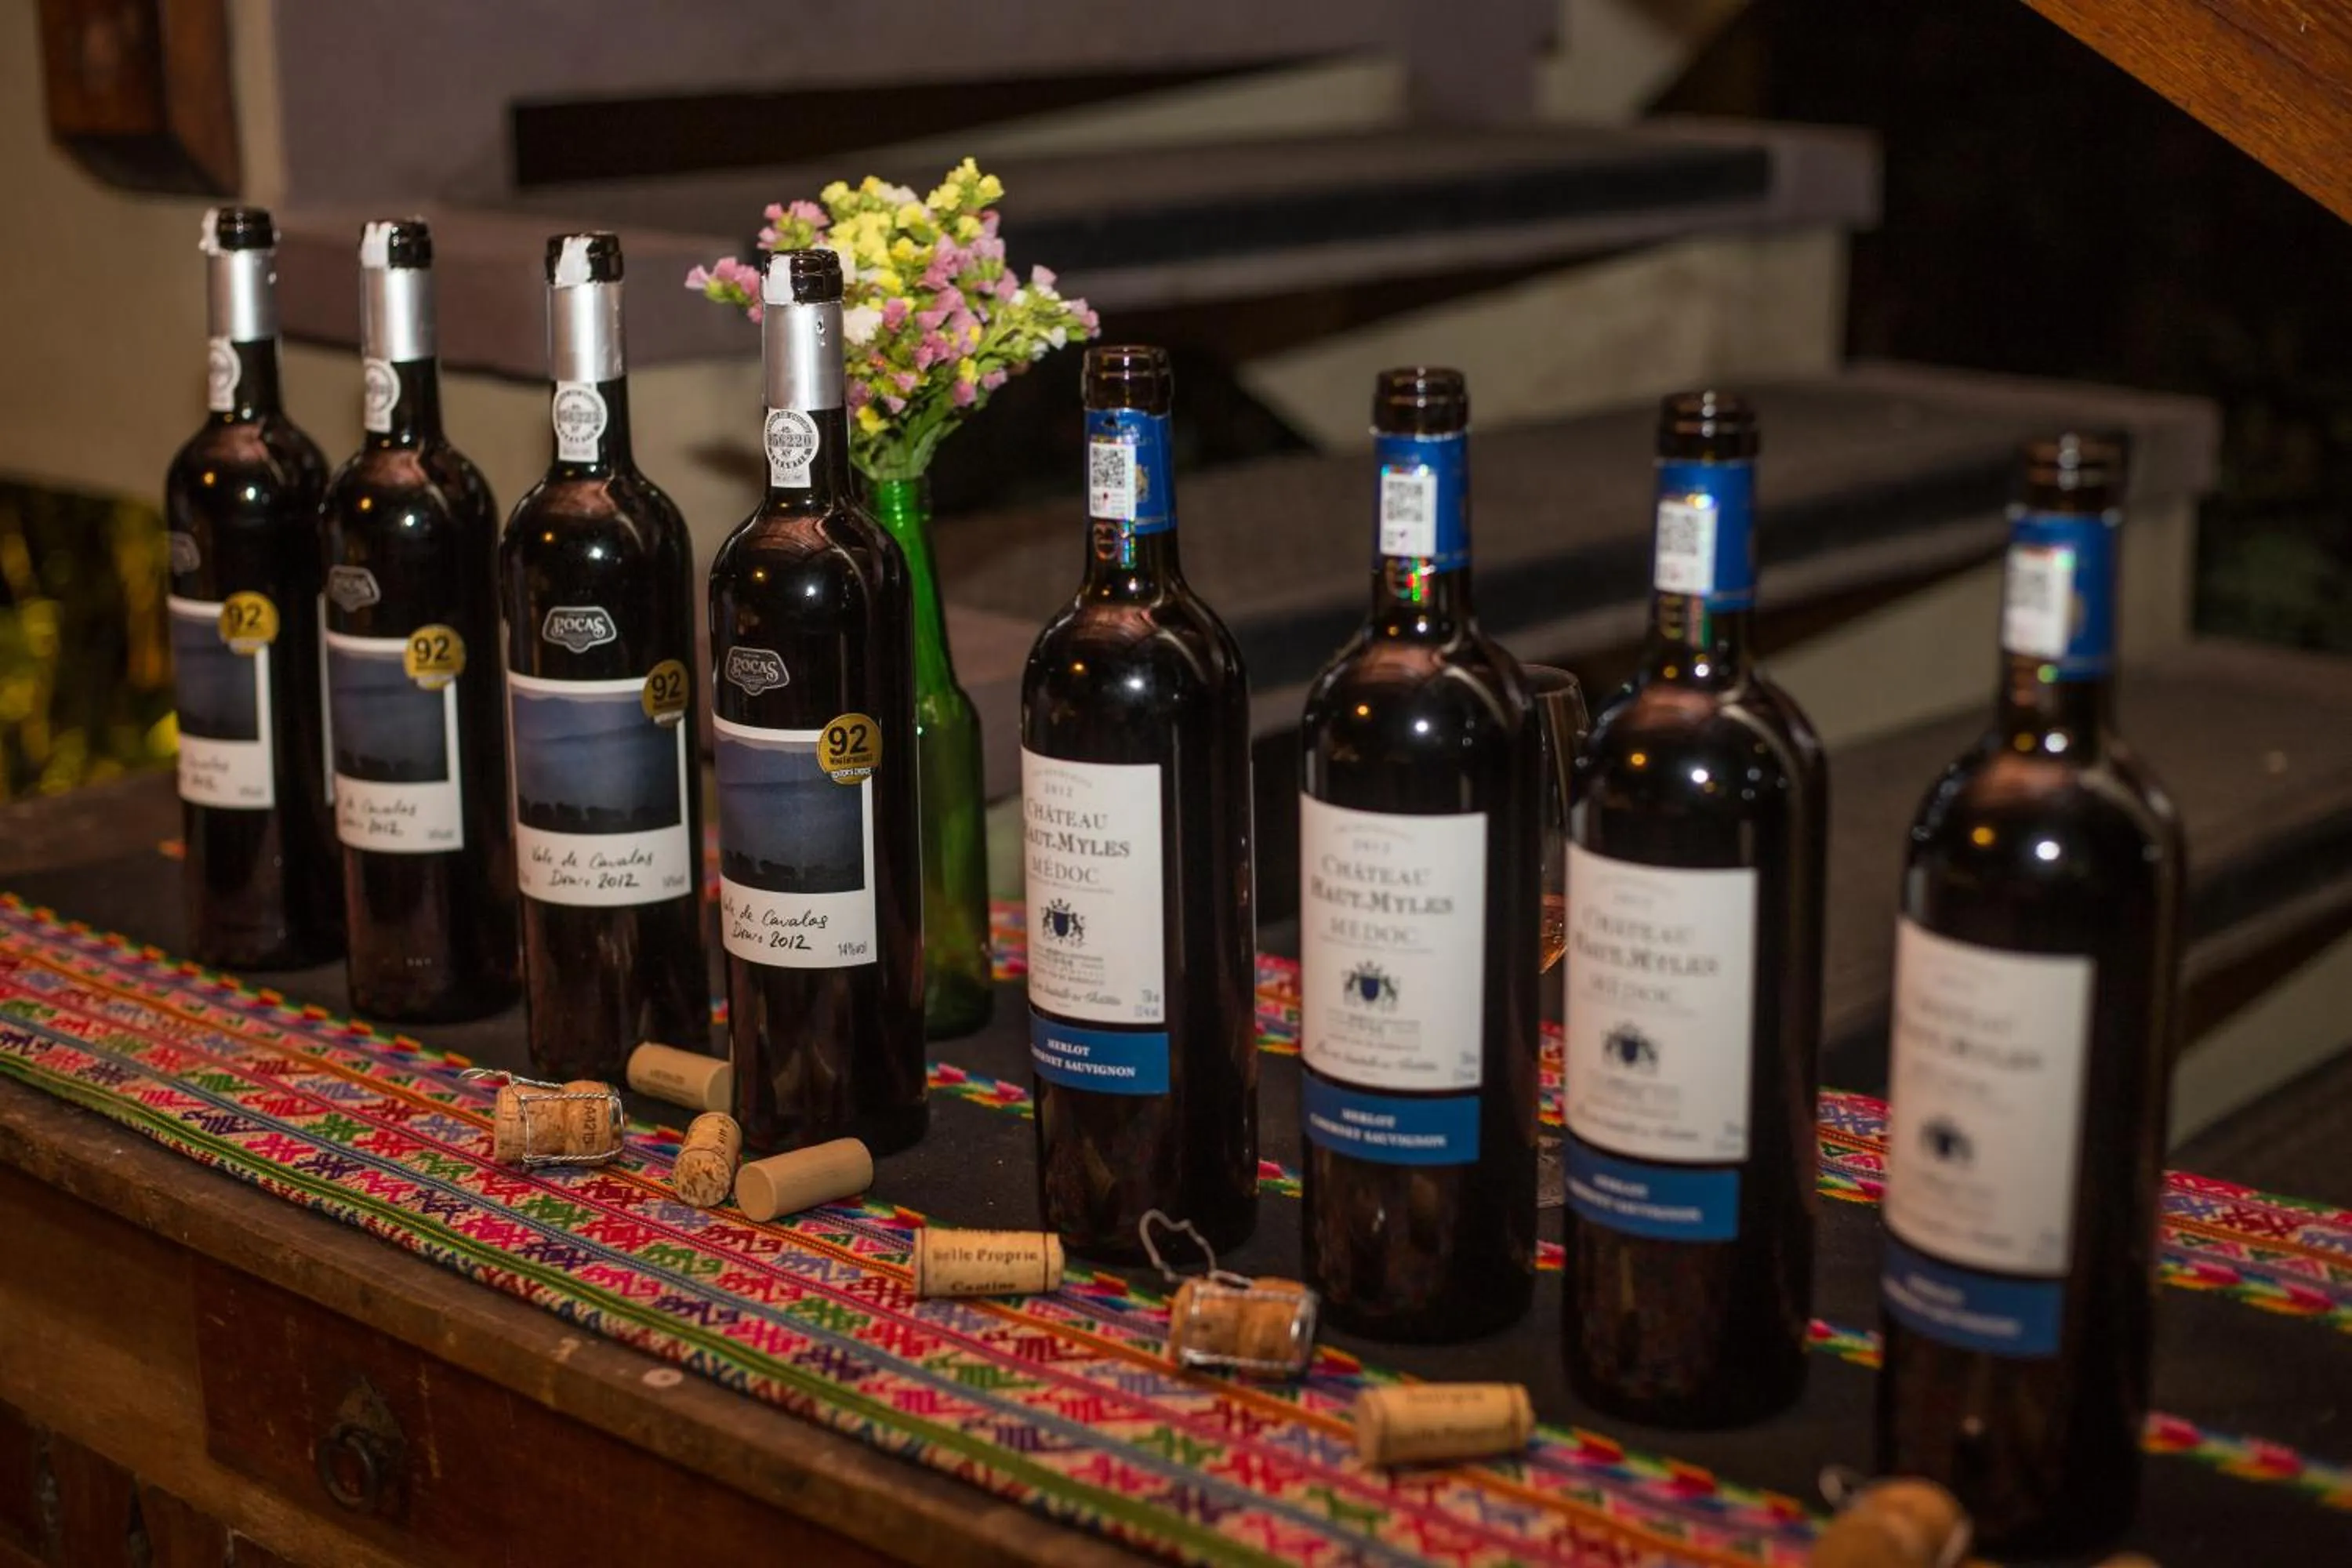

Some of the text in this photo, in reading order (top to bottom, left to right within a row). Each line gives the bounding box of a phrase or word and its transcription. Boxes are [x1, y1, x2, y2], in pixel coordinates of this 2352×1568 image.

[413, 635, 450, 662] 92
[652, 670, 681, 702] 92
[828, 724, 868, 756] 92
[597, 873, 640, 888] 2012
[739, 903, 753, 922] de
[770, 931, 811, 950] 2012
[1047, 1039, 1091, 1057] MERLOT
[1064, 1059, 1136, 1077] SAUVIGNON
